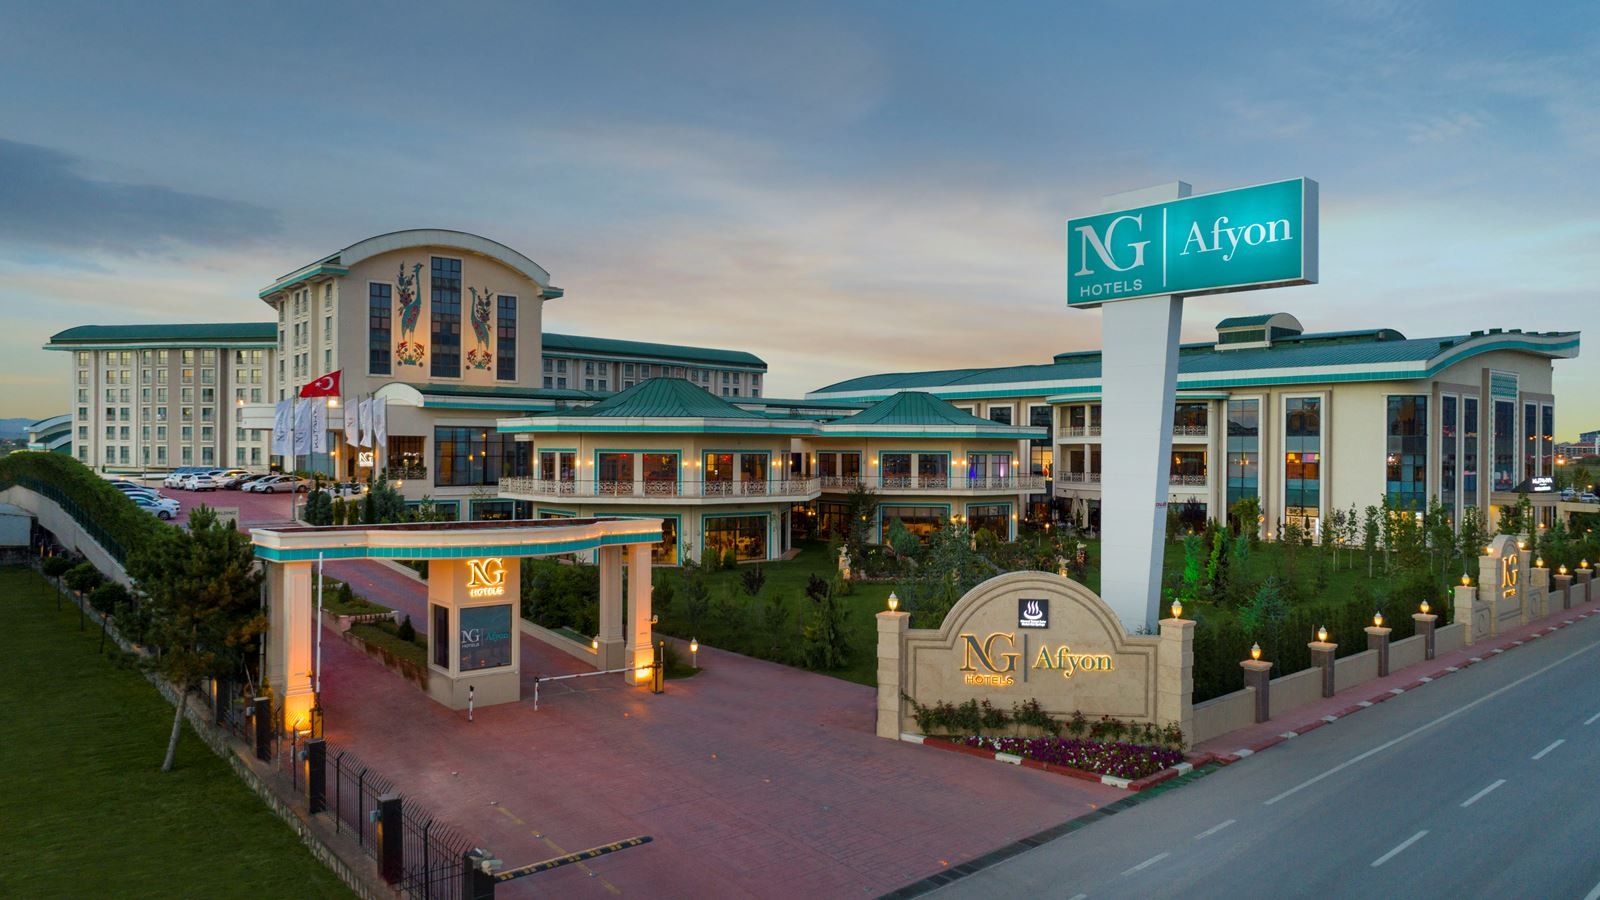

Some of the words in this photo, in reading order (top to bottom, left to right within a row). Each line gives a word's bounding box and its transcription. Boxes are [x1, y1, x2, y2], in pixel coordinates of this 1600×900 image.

[1074, 214, 1150, 276] NG
[1180, 216, 1293, 261] Afyon
[1080, 279, 1143, 297] HOTELS
[467, 558, 507, 587] NG
[461, 629, 480, 643] NG
[959, 632, 1020, 673] NG
[1033, 645, 1113, 678] Afyon
[965, 674, 1014, 686] HOTELS
